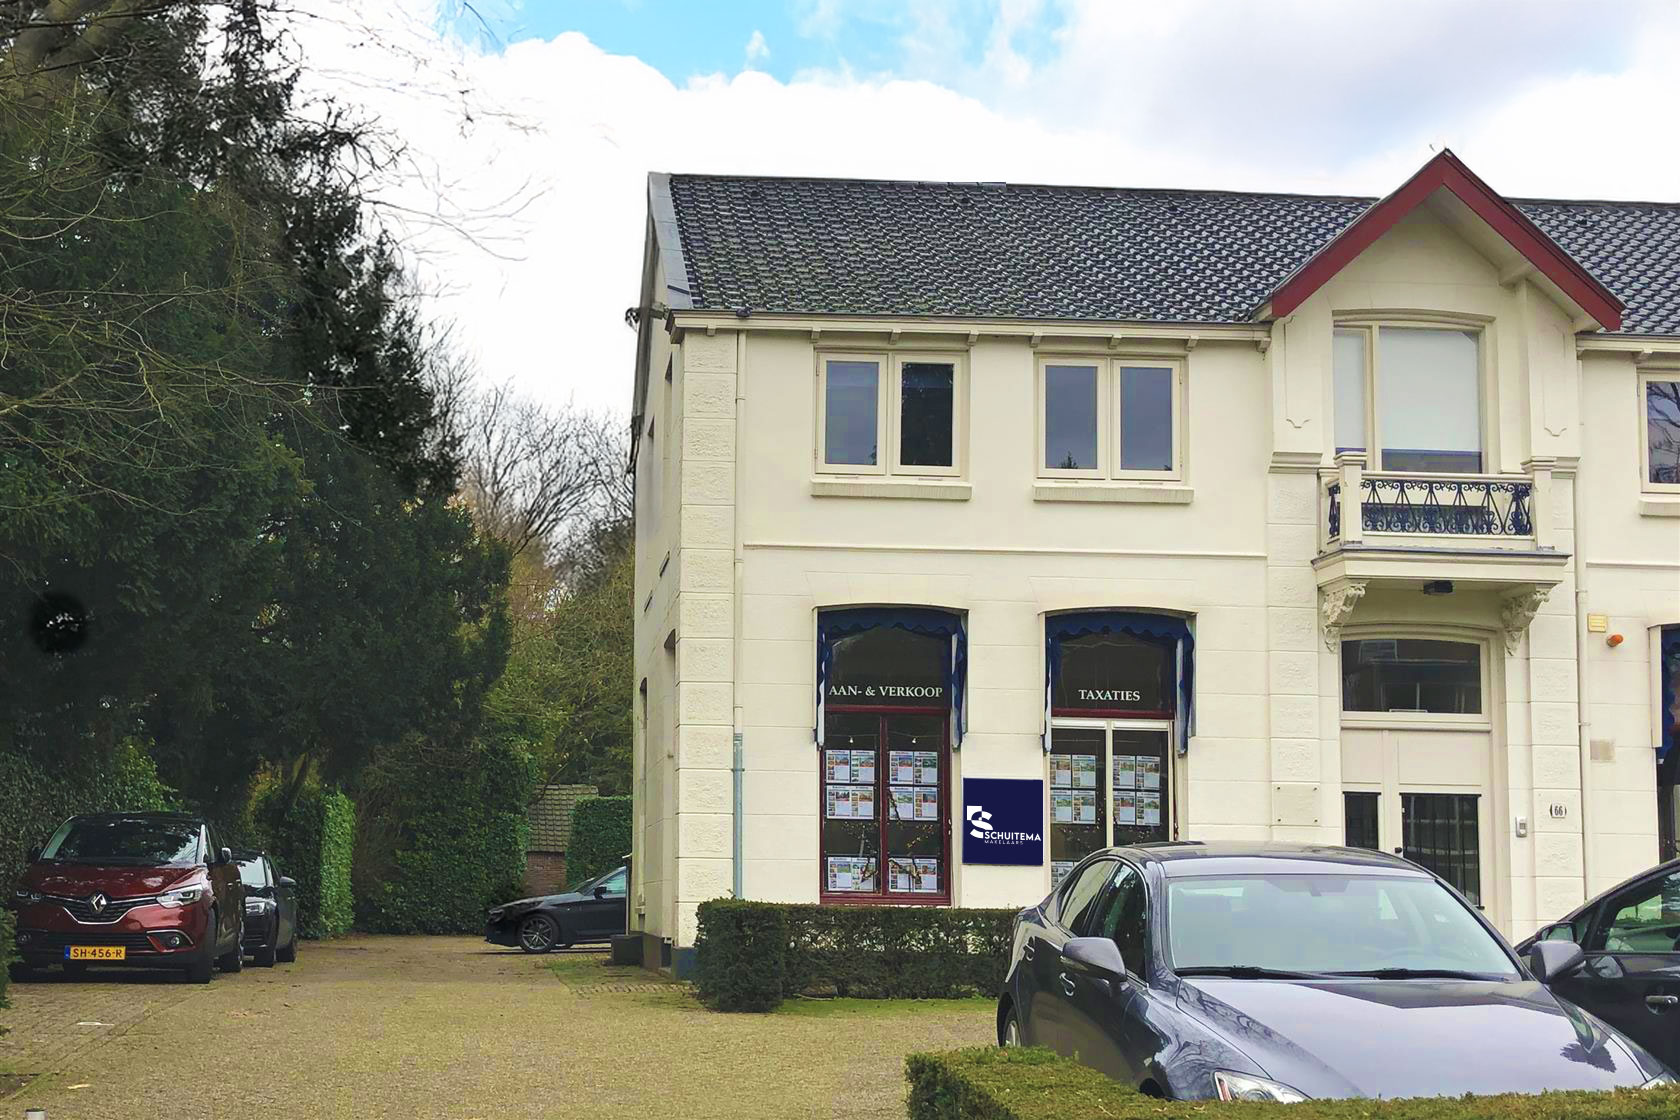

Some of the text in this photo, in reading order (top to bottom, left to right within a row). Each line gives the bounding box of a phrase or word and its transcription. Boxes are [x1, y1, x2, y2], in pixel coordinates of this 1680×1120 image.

[829, 685, 943, 698] AAN- & VERKOOP
[1078, 689, 1141, 702] TAXATIES
[1554, 805, 1564, 816] 66
[984, 831, 1042, 842] SCHUITEMA
[73, 948, 123, 958] SH-456-R
